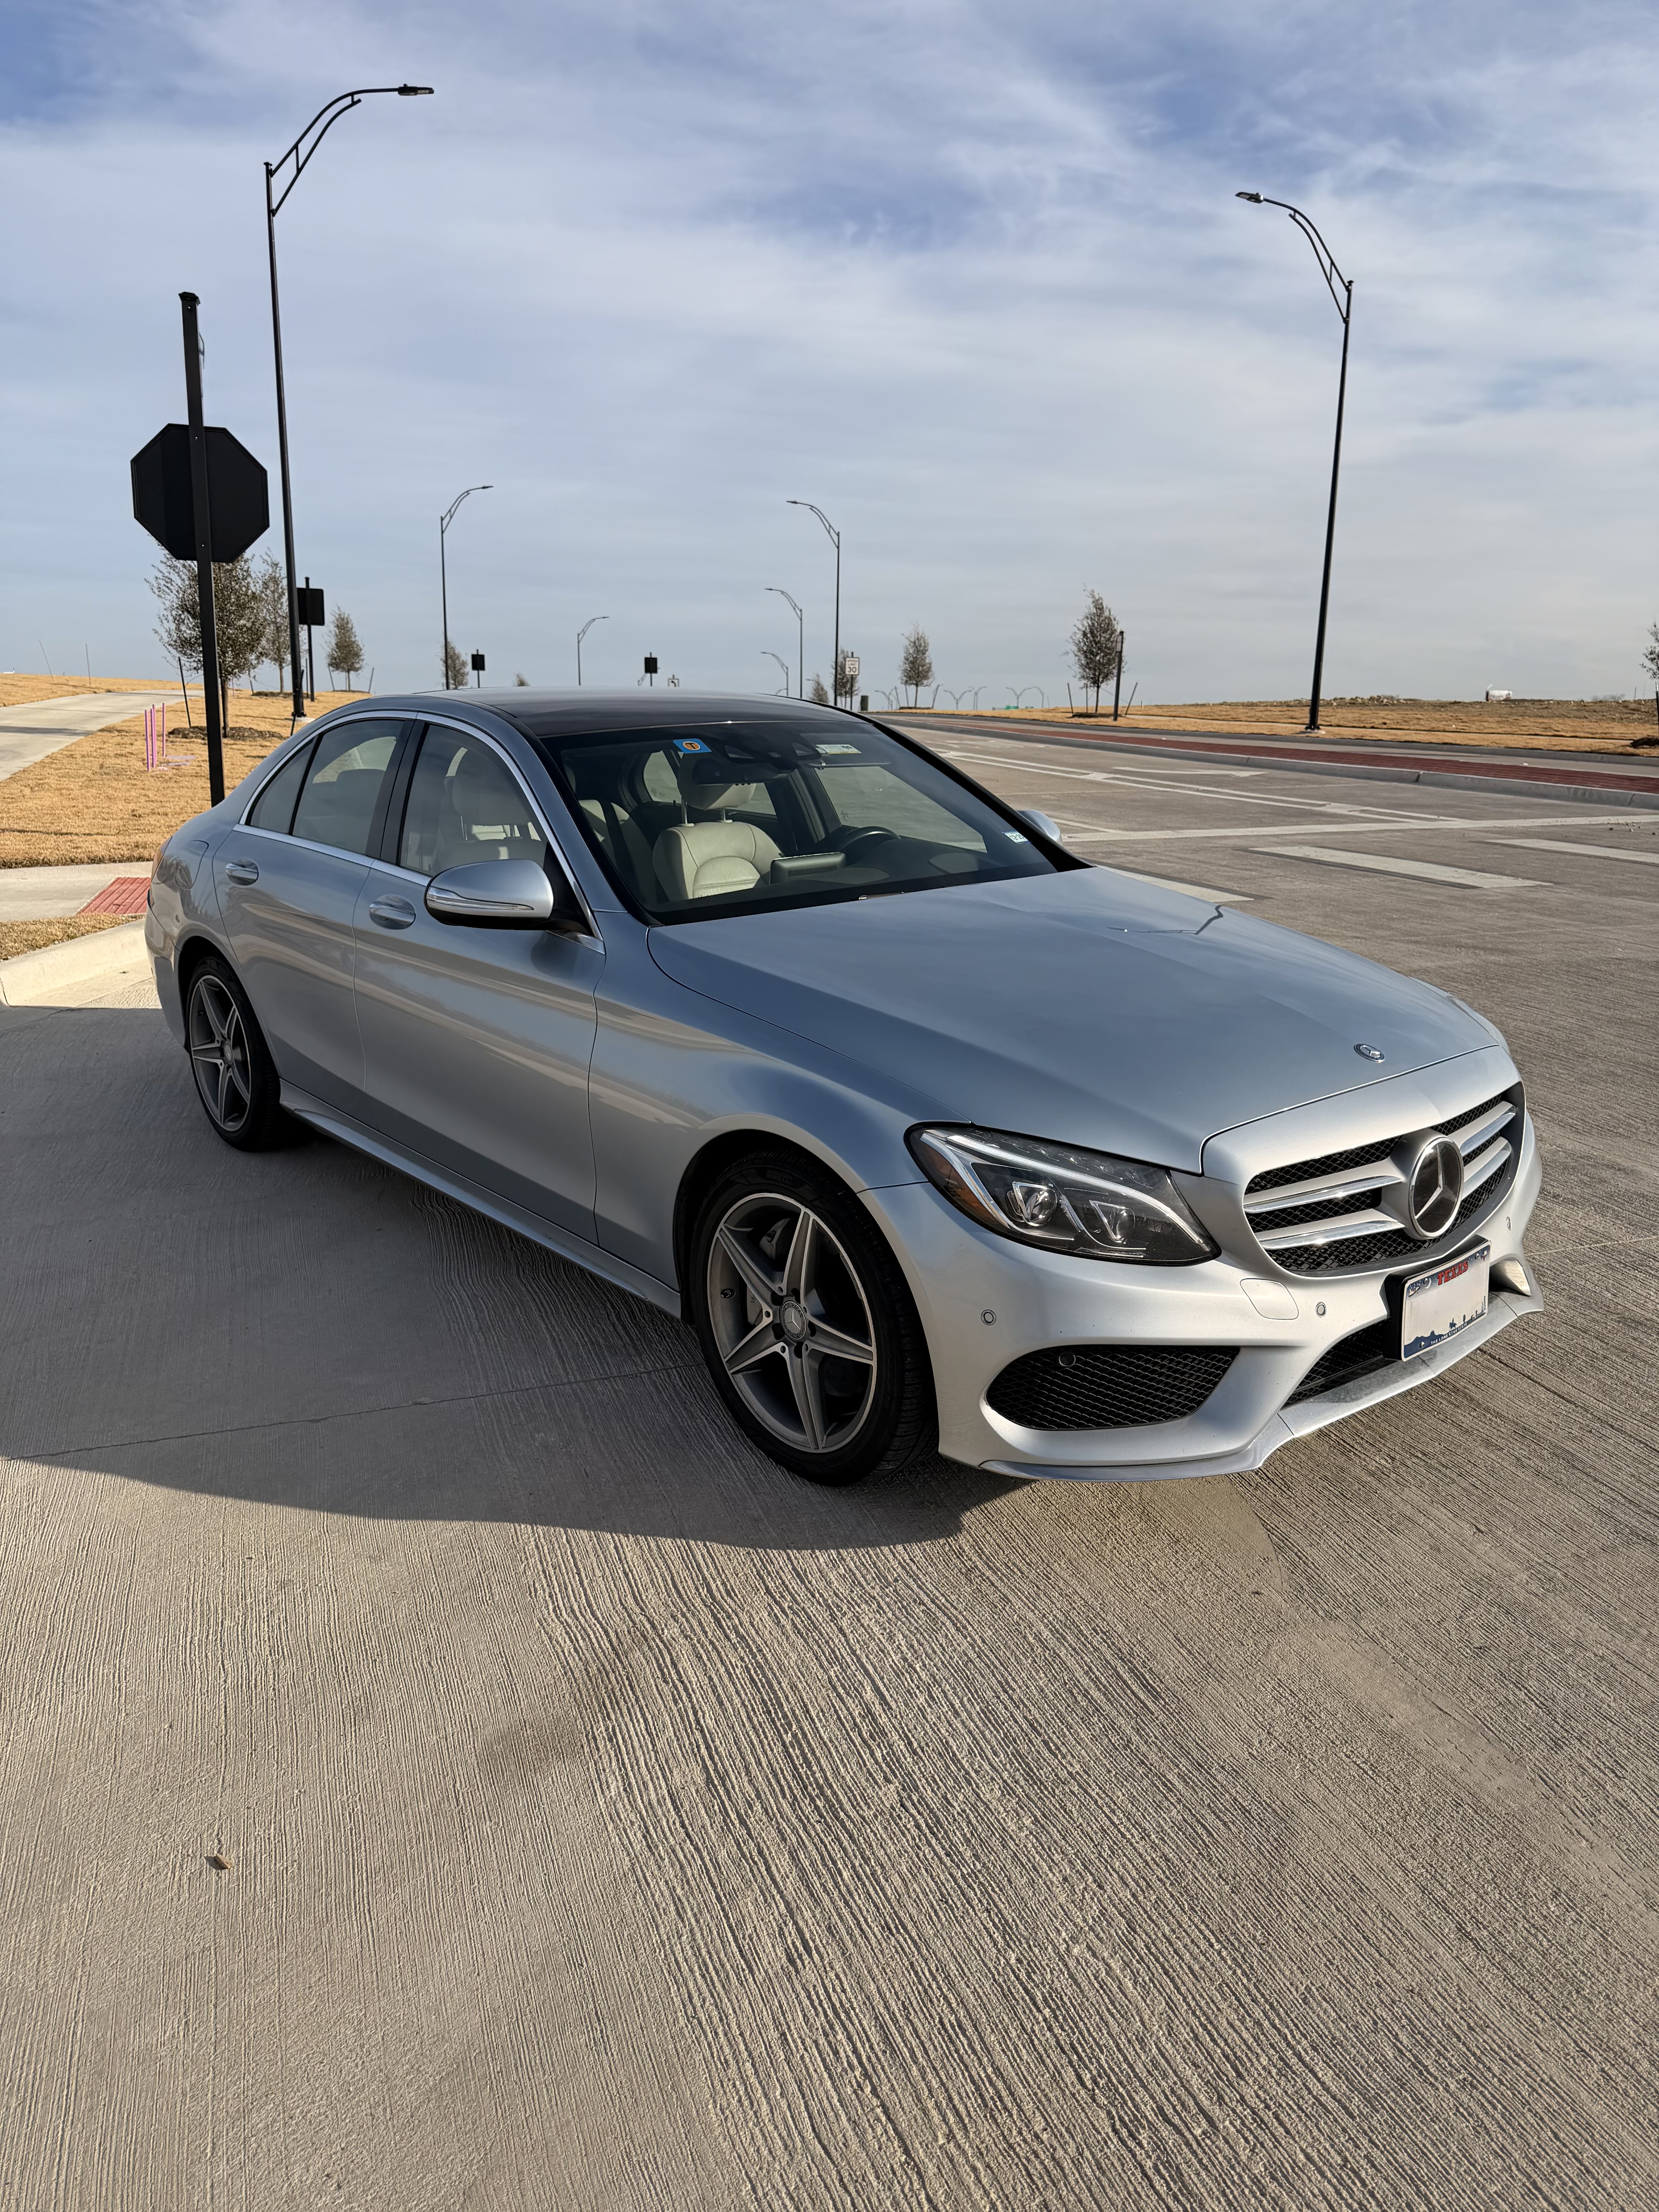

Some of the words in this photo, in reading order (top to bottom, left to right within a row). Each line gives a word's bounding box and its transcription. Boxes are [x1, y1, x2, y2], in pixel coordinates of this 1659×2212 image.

[1437, 1260, 1468, 1285] TEXAS
[1449, 1328, 1458, 1336] STAR
[1458, 1322, 1467, 1331] STATE
